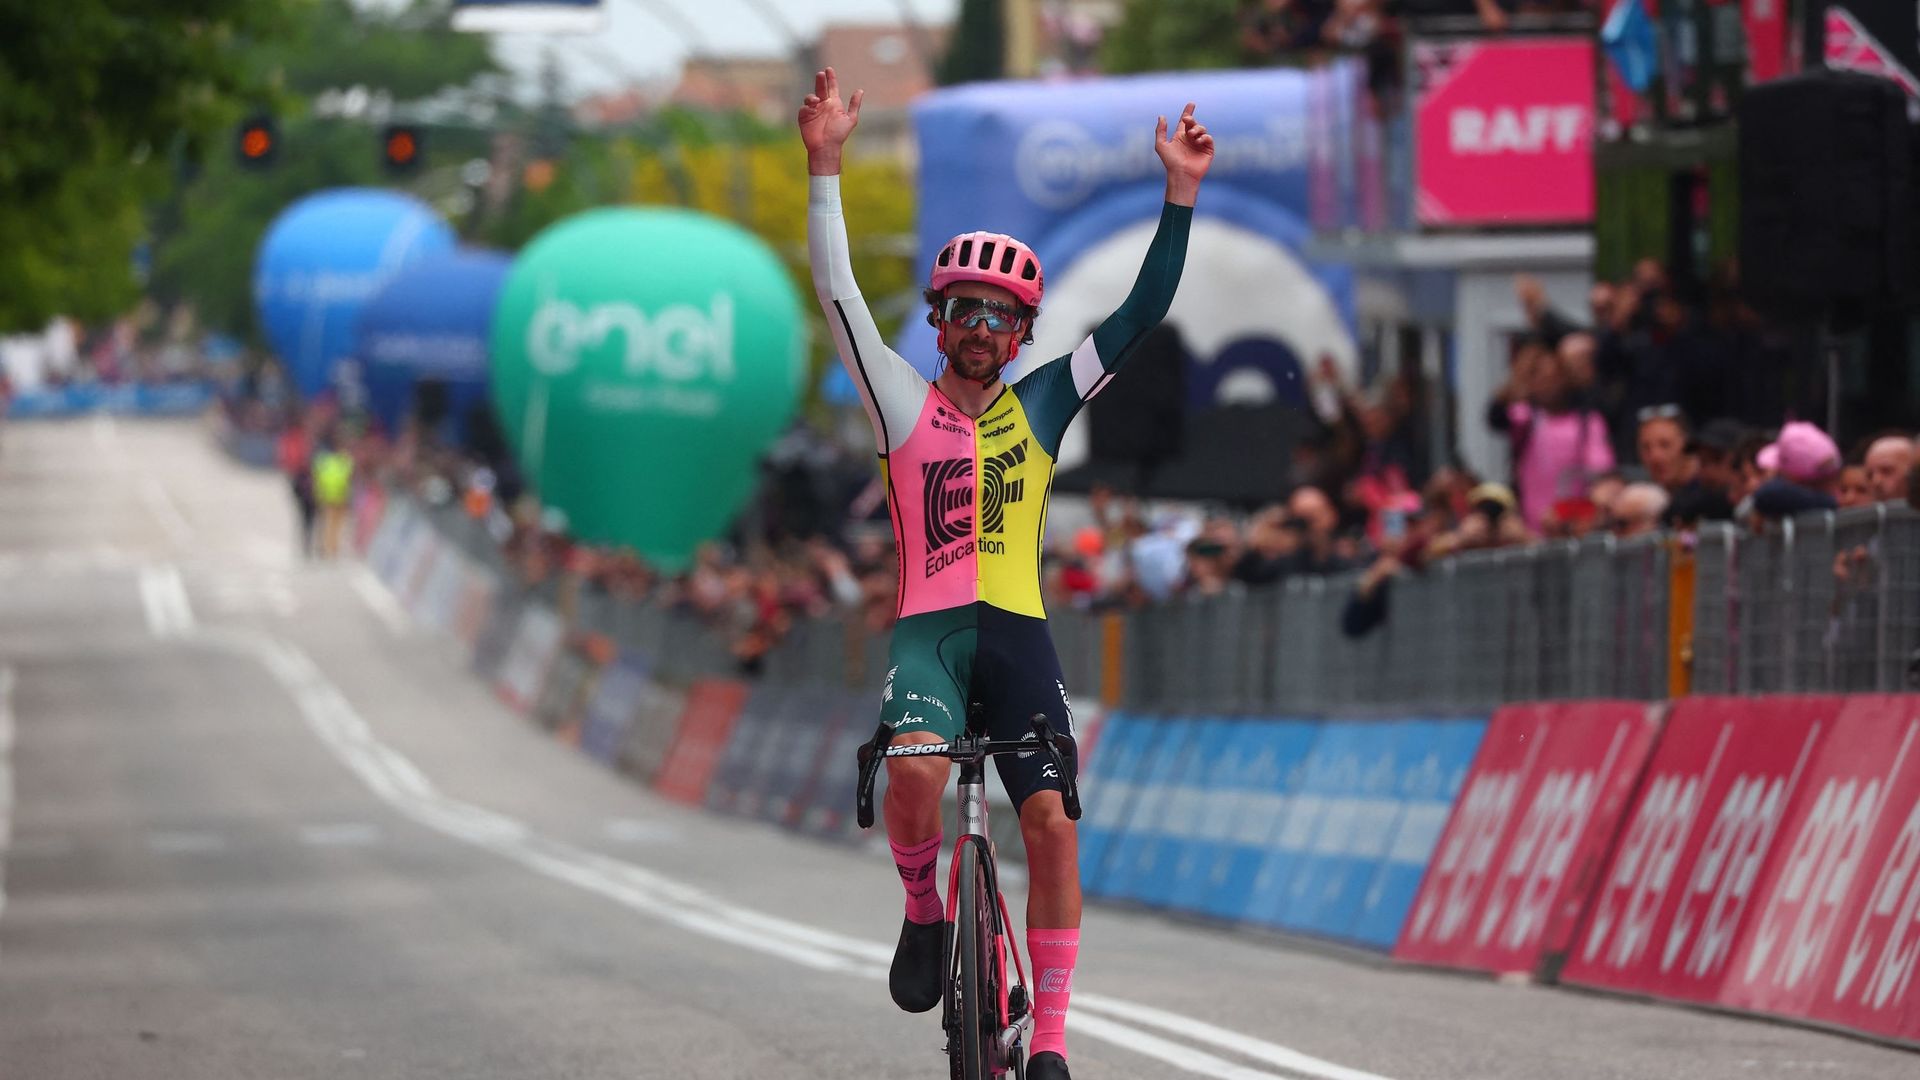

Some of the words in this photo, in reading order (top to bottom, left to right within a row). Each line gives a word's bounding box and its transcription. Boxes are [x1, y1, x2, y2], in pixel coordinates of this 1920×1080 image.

[527, 291, 735, 381] enel
[942, 423, 971, 437] NIPPO
[988, 407, 1014, 424] easypost
[982, 423, 1015, 439] wahoo
[925, 537, 1005, 579] Education
[1743, 718, 1919, 993] enel
